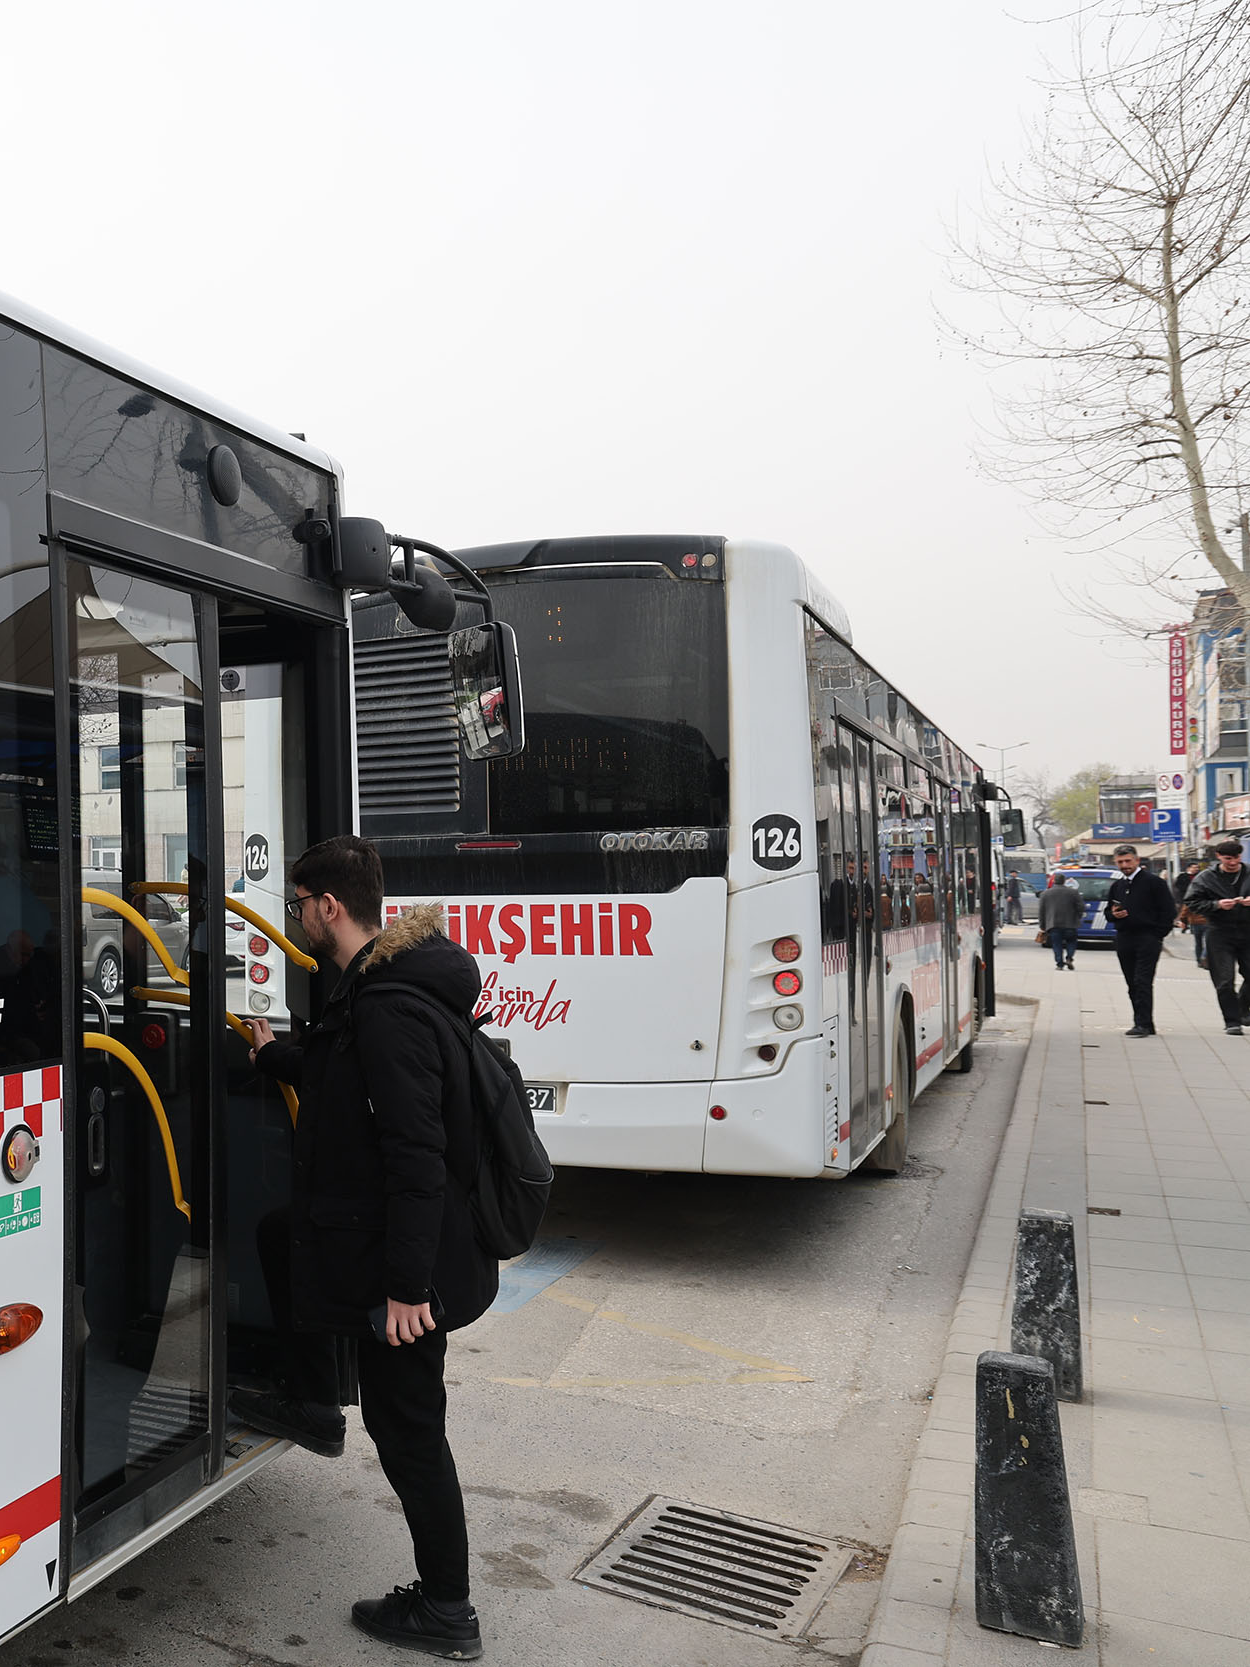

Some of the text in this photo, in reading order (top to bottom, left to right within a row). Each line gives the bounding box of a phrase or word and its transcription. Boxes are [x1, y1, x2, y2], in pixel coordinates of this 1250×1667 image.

[1172, 701, 1184, 749] KURSU
[1153, 811, 1172, 831] P
[600, 831, 710, 851] OTOKAR
[753, 827, 800, 858] 126
[245, 844, 268, 871] 126
[498, 986, 535, 1005] için
